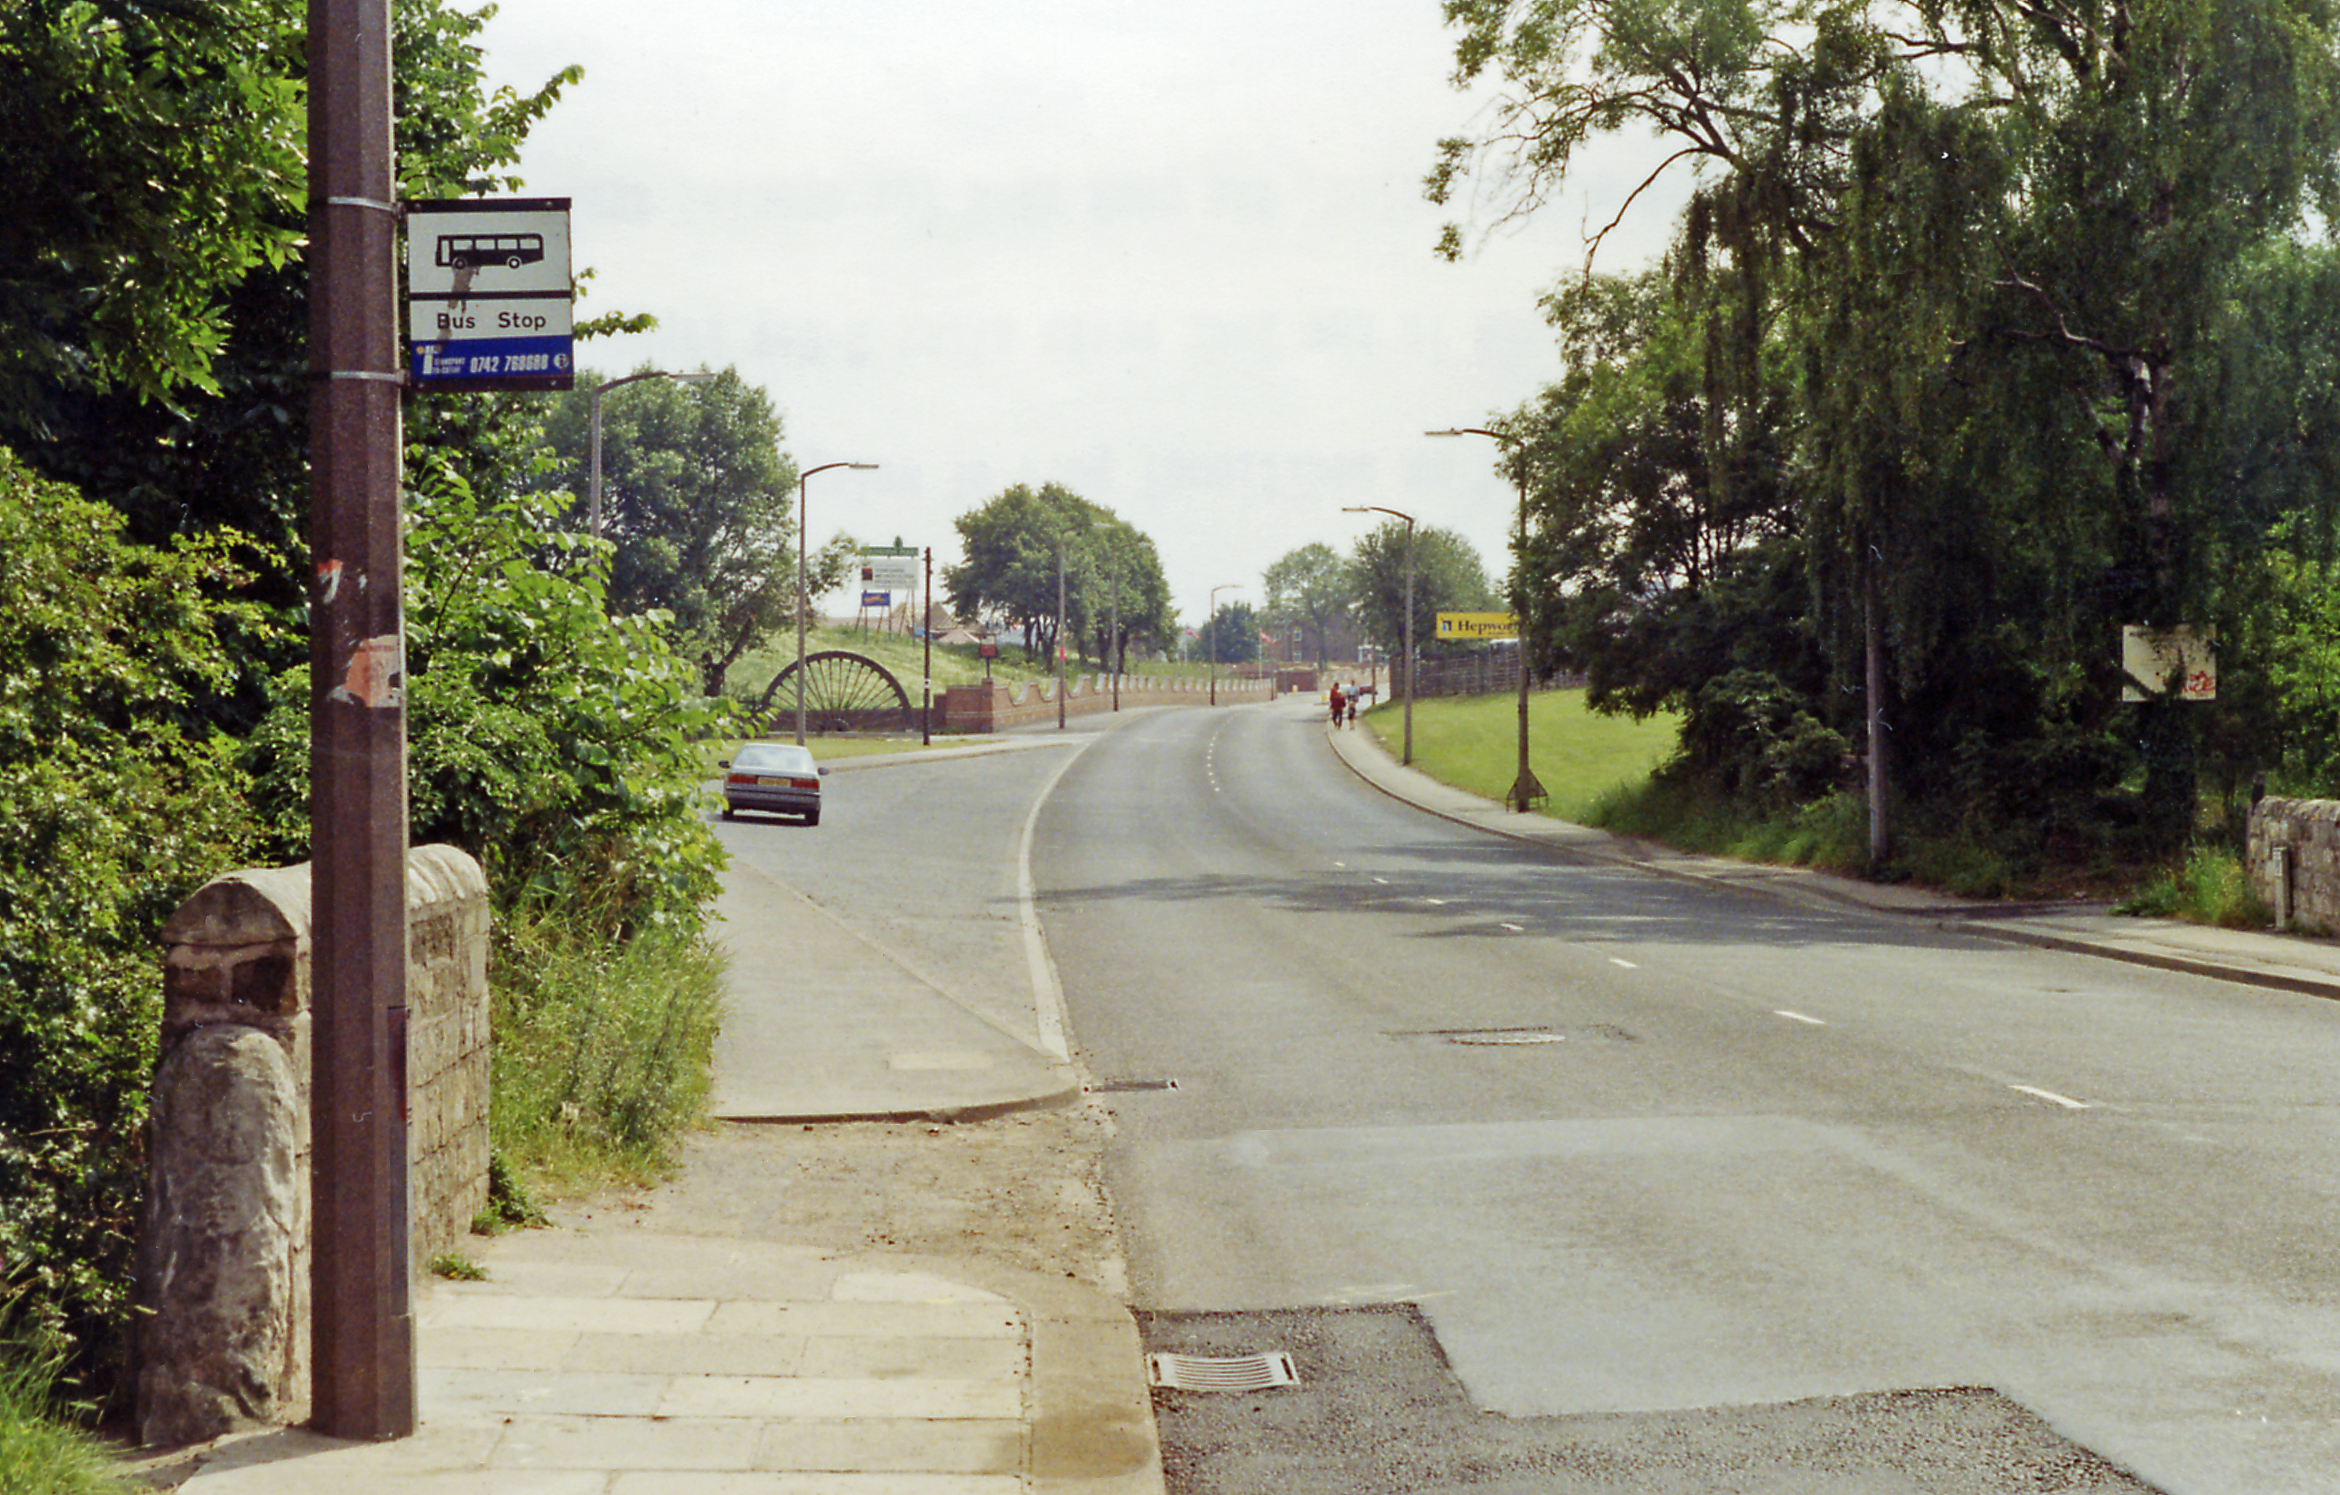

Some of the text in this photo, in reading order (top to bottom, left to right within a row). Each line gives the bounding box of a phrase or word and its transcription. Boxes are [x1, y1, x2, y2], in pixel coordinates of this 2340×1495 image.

[437, 311, 546, 331] Bus Stop
[469, 356, 499, 373] 0742
